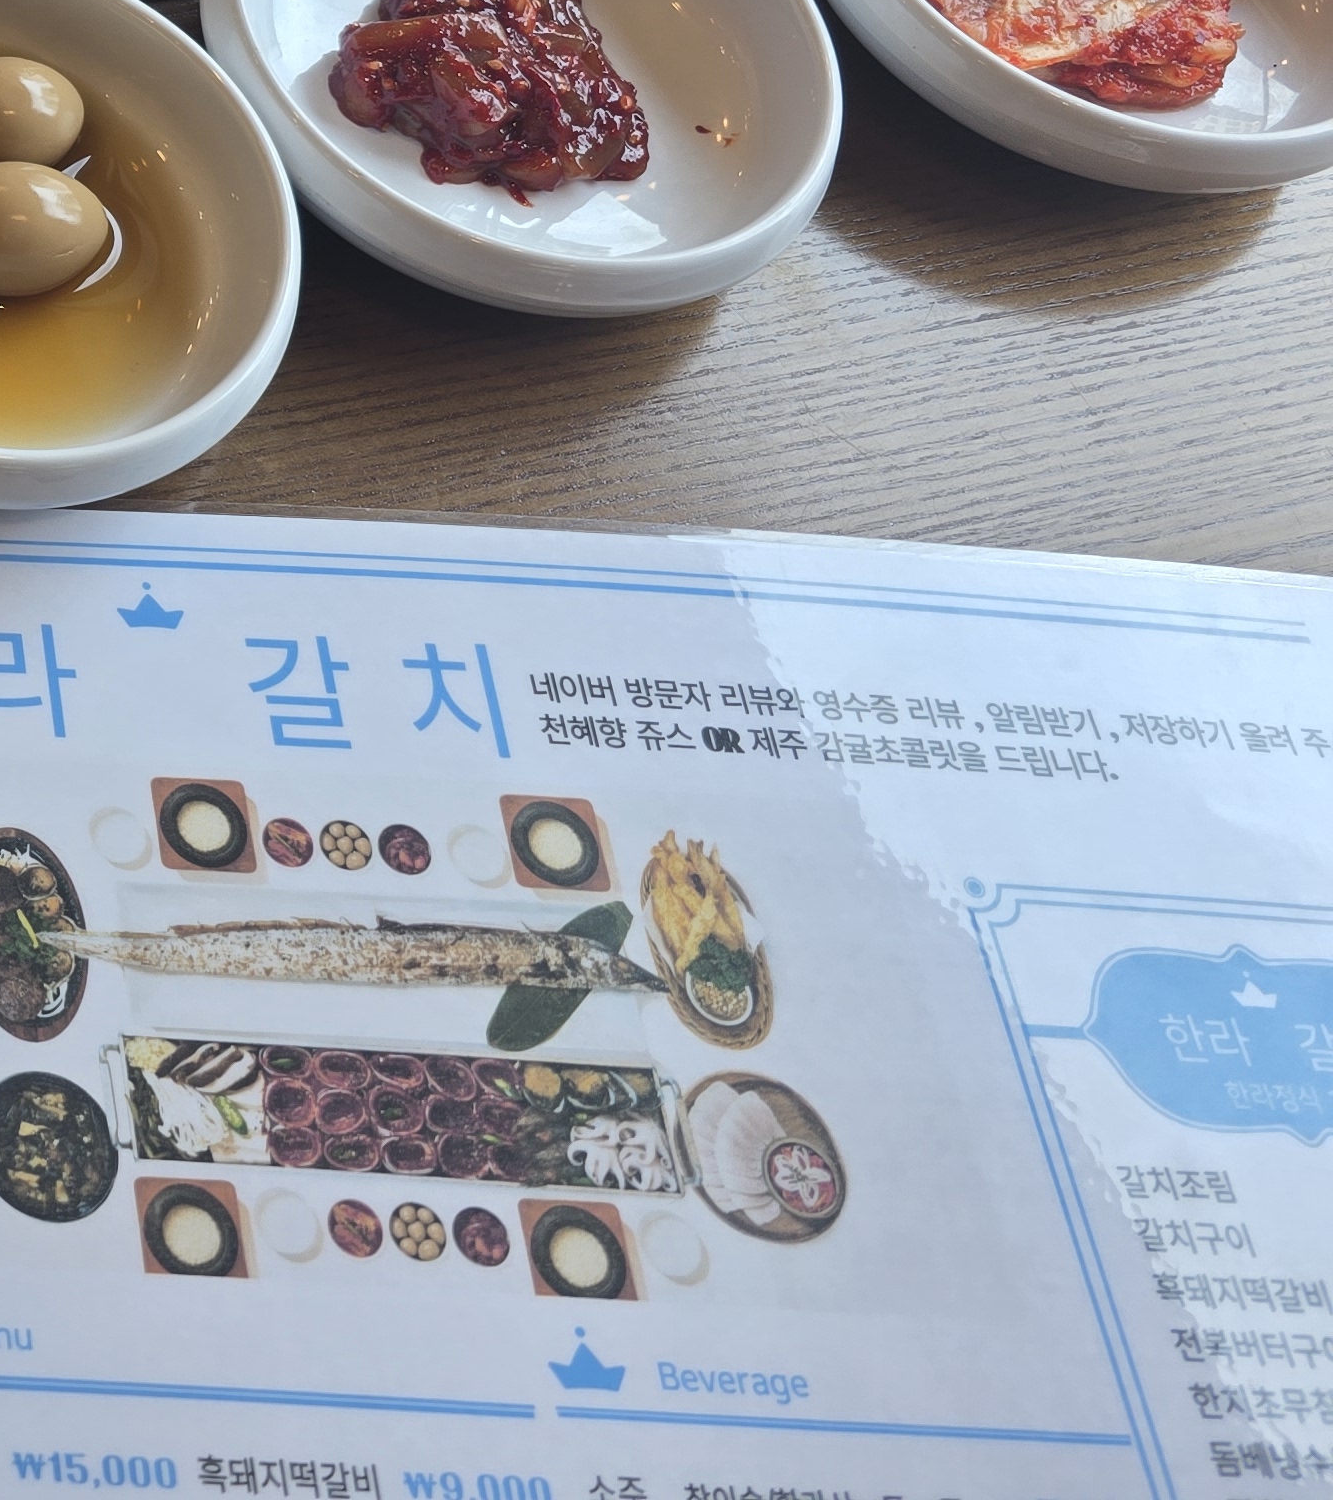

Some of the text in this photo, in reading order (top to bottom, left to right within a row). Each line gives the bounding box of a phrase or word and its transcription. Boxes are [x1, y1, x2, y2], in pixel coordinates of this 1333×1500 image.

[244, 635, 511, 758] 갈치
[529, 672, 617, 706] 네이버
[623, 677, 711, 712] 방문자
[718, 684, 805, 718] 리뷰와
[812, 690, 899, 725] 영수증
[905, 697, 965, 730] 리뷰
[1238, 721, 1298, 756] 올려
[538, 713, 1119, 782] 천혜향 쥬스 OR 제주 감귤초콜릿을 드립니다.
[1158, 1013, 1252, 1067] 한라
[1224, 1080, 1324, 1115] 한라정식
[1116, 1165, 1237, 1204] 갈치조림
[1133, 1217, 1257, 1258] 갈치구이
[657, 1361, 809, 1404] Beverage
[13, 1451, 177, 1489] ₩15,000
[197, 1455, 382, 1500] 흑돼지떡갈비
[1208, 1441, 1333, 1481] 돔베냉수
